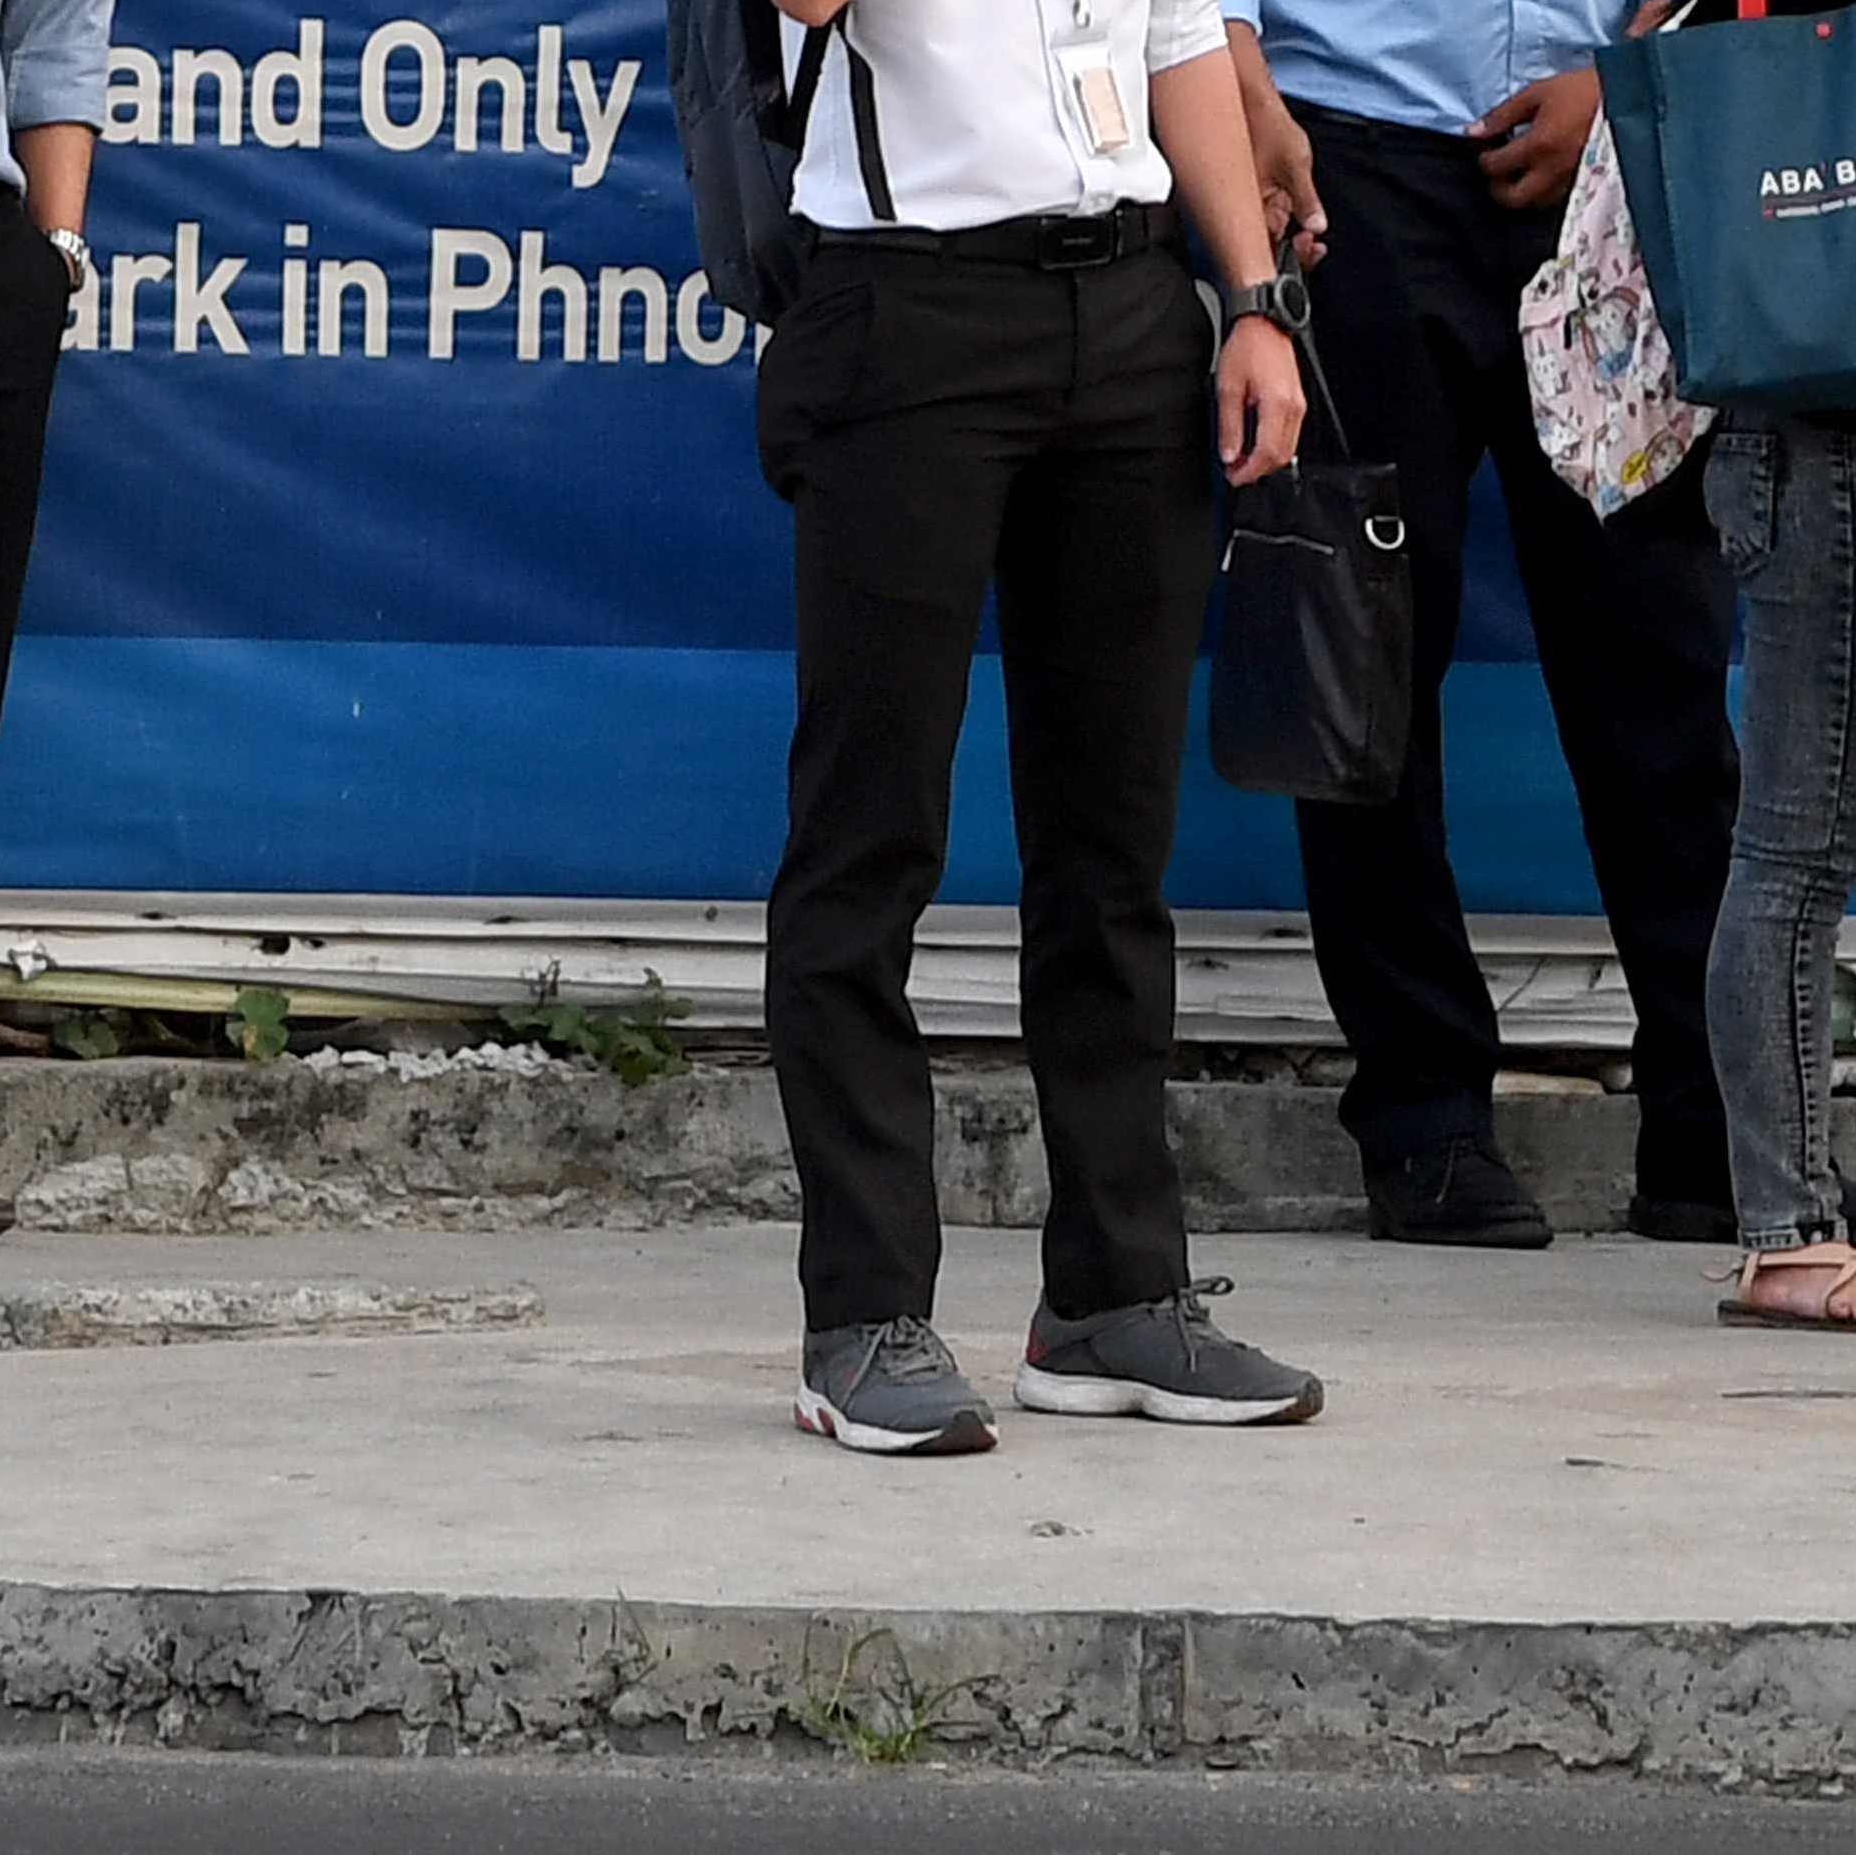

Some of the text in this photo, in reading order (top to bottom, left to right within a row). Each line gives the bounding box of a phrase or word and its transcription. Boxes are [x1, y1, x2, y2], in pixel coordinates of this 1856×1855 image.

[358, 18, 642, 190] Only
[283, 223, 389, 358] in
[428, 227, 774, 366] Phno
